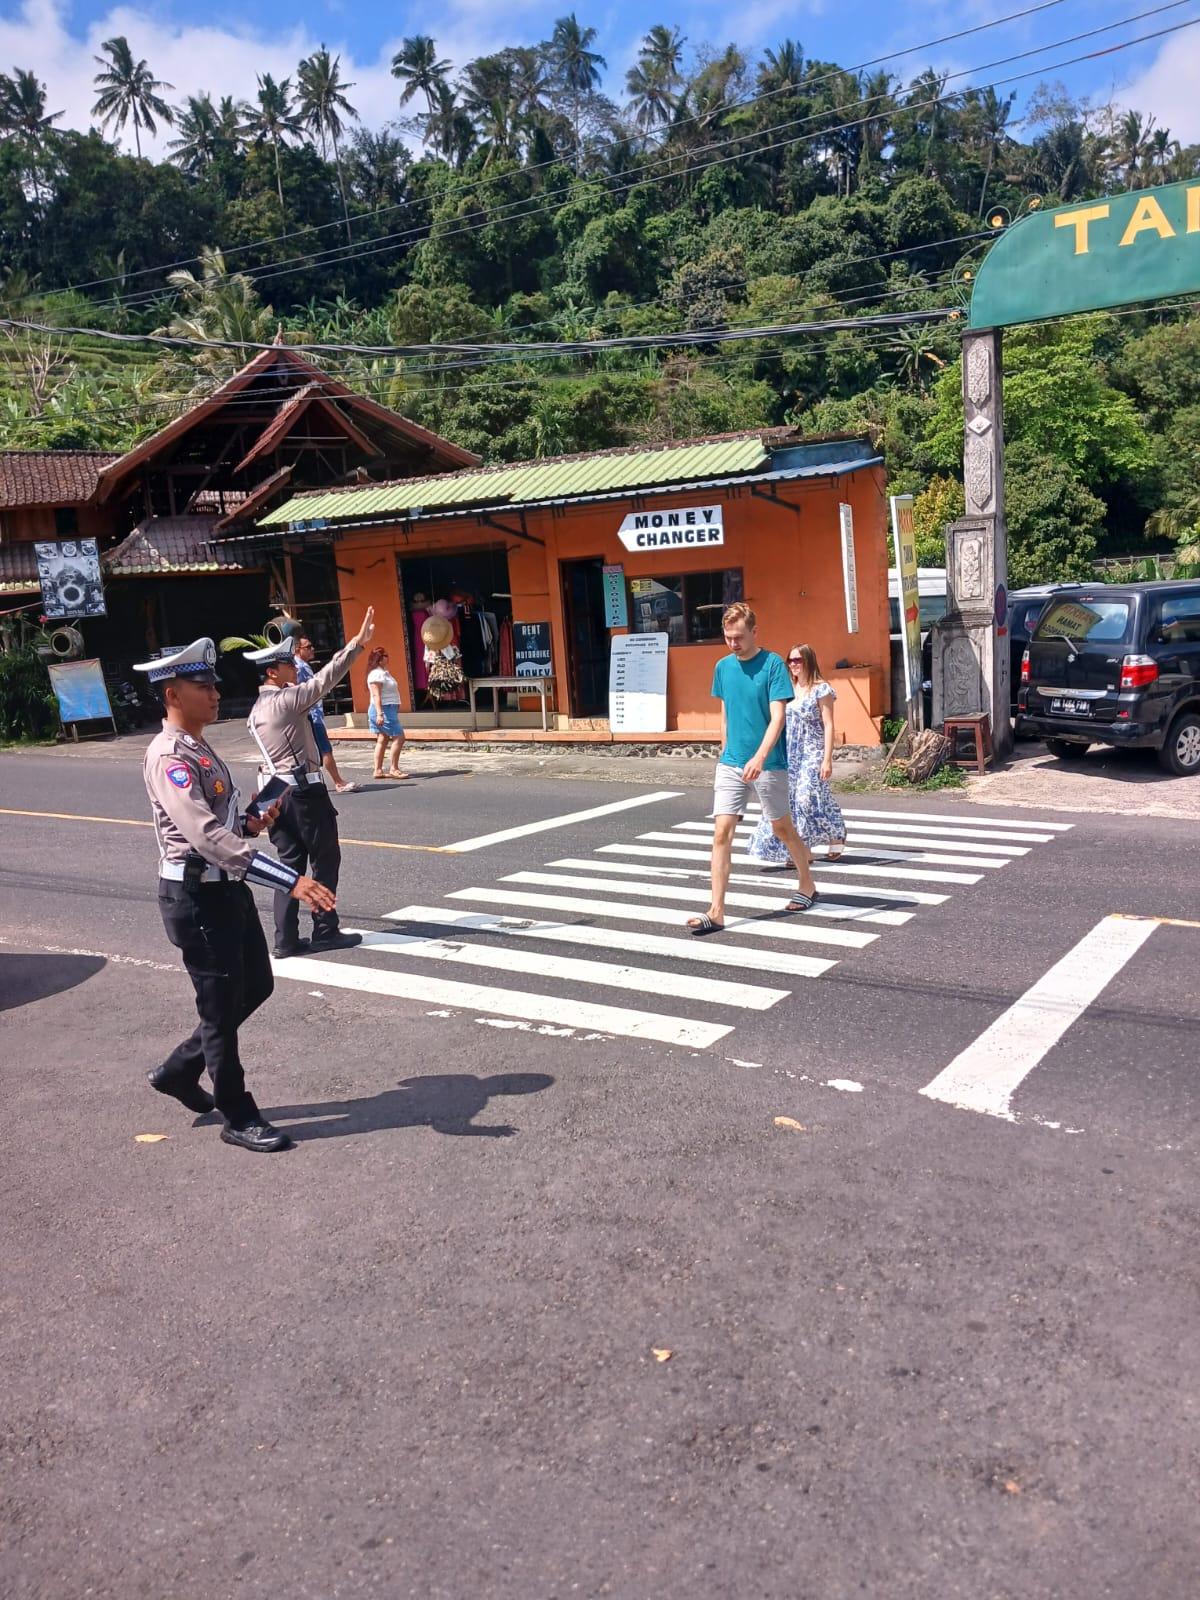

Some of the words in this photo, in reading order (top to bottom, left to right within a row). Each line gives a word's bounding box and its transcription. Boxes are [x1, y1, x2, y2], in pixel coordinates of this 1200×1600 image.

[1054, 186, 1200, 255] TA
[635, 510, 713, 529] MONEY
[636, 528, 720, 546] CHANGER
[522, 625, 541, 635] RENT
[516, 650, 550, 659] MOTORBIKE
[517, 668, 551, 676] MONEY
